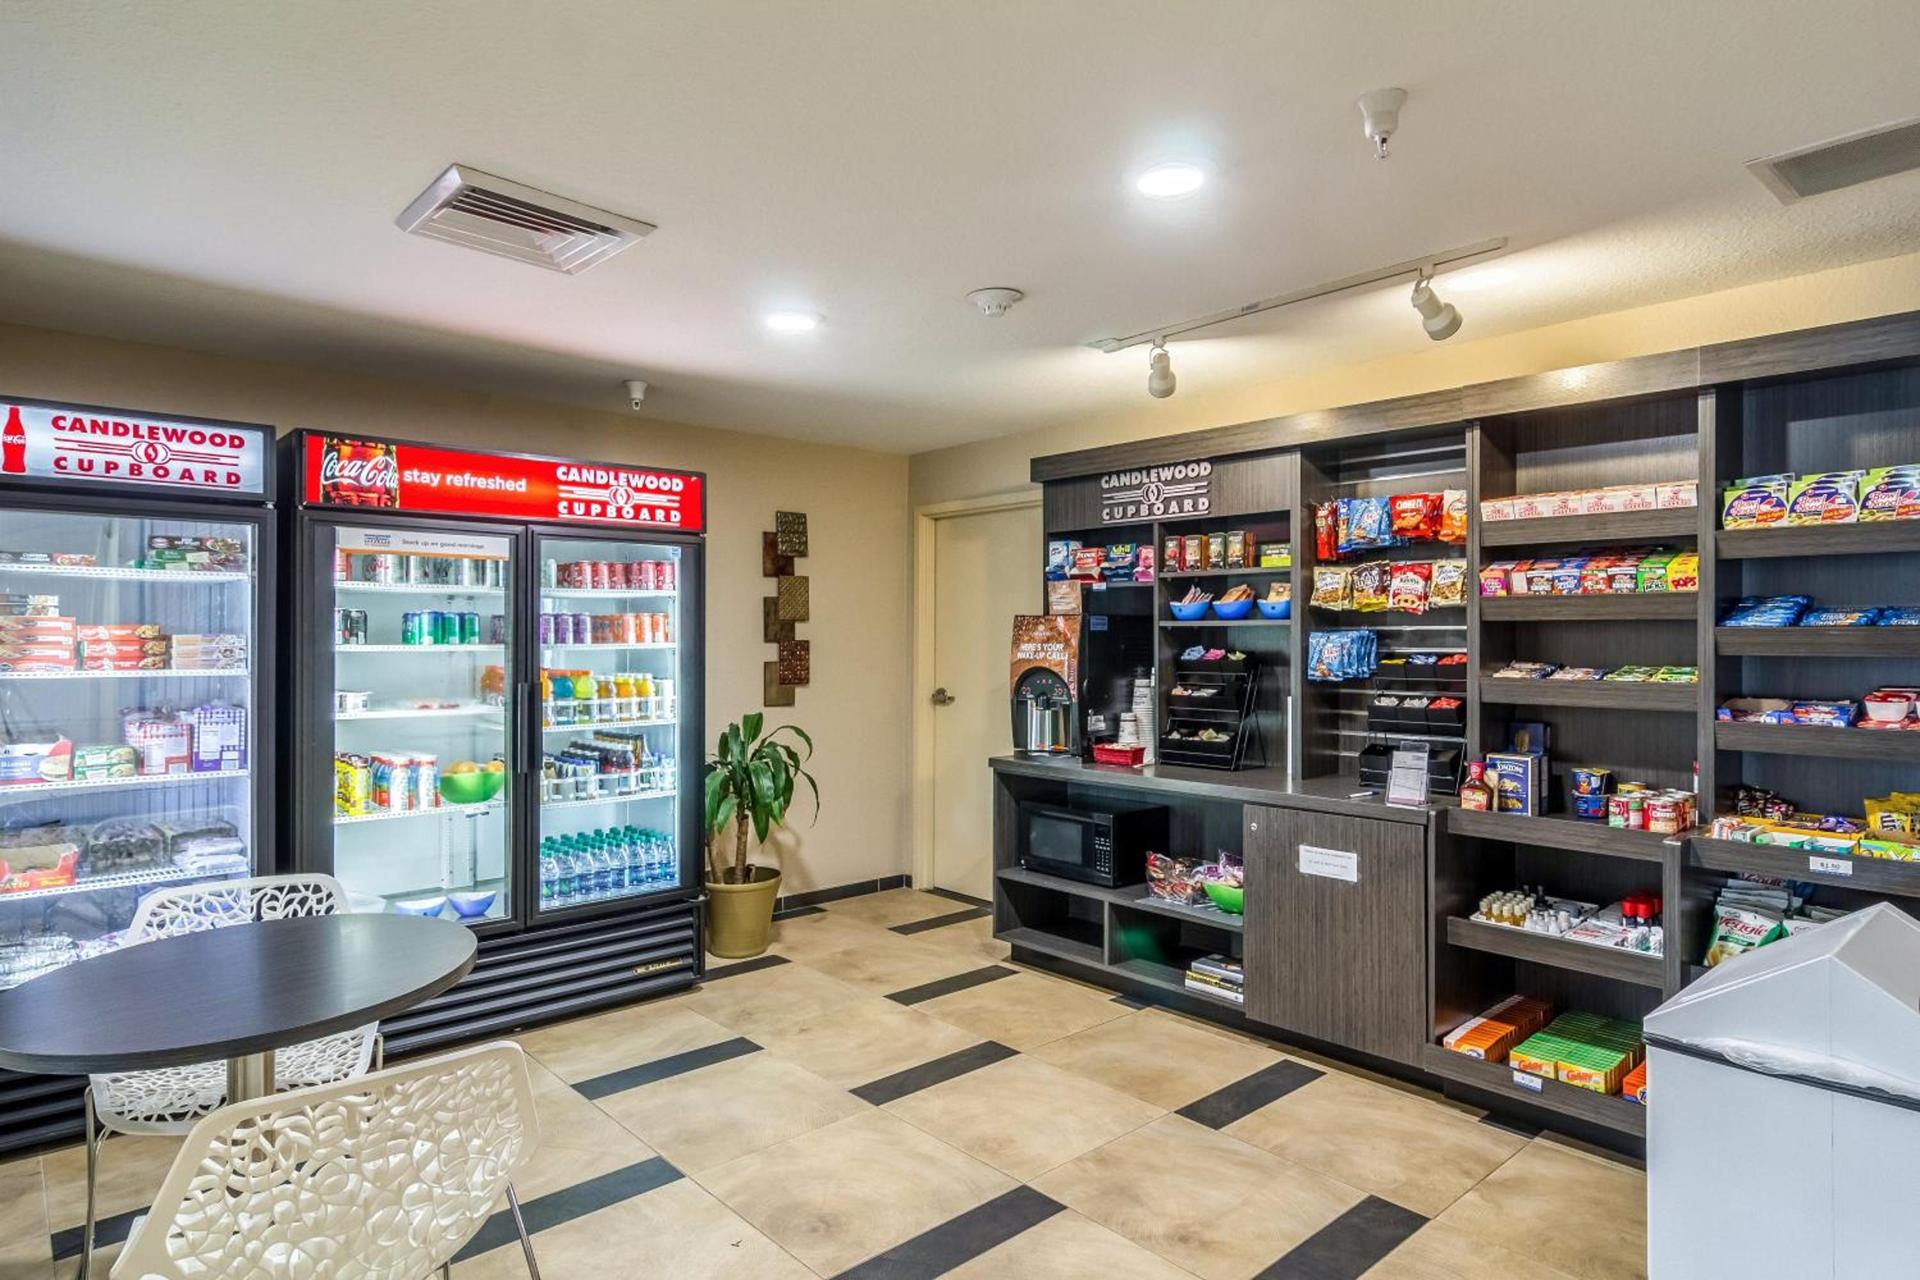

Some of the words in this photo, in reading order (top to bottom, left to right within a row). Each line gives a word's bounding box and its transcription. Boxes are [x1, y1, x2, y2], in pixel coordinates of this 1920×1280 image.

[51, 415, 245, 449] CANDLEWOOD
[54, 457, 241, 485] CUPBOARD
[322, 451, 398, 488] Coca-Cola
[403, 469, 441, 487] stay
[446, 472, 527, 492] refreshed
[556, 466, 684, 491] CANDLEWOOD
[1101, 461, 1212, 488] CANDLEWOOD
[557, 501, 682, 523] CUPBOARD
[1102, 497, 1209, 520] CUPBOARD
[1671, 576, 1697, 590] POPS
